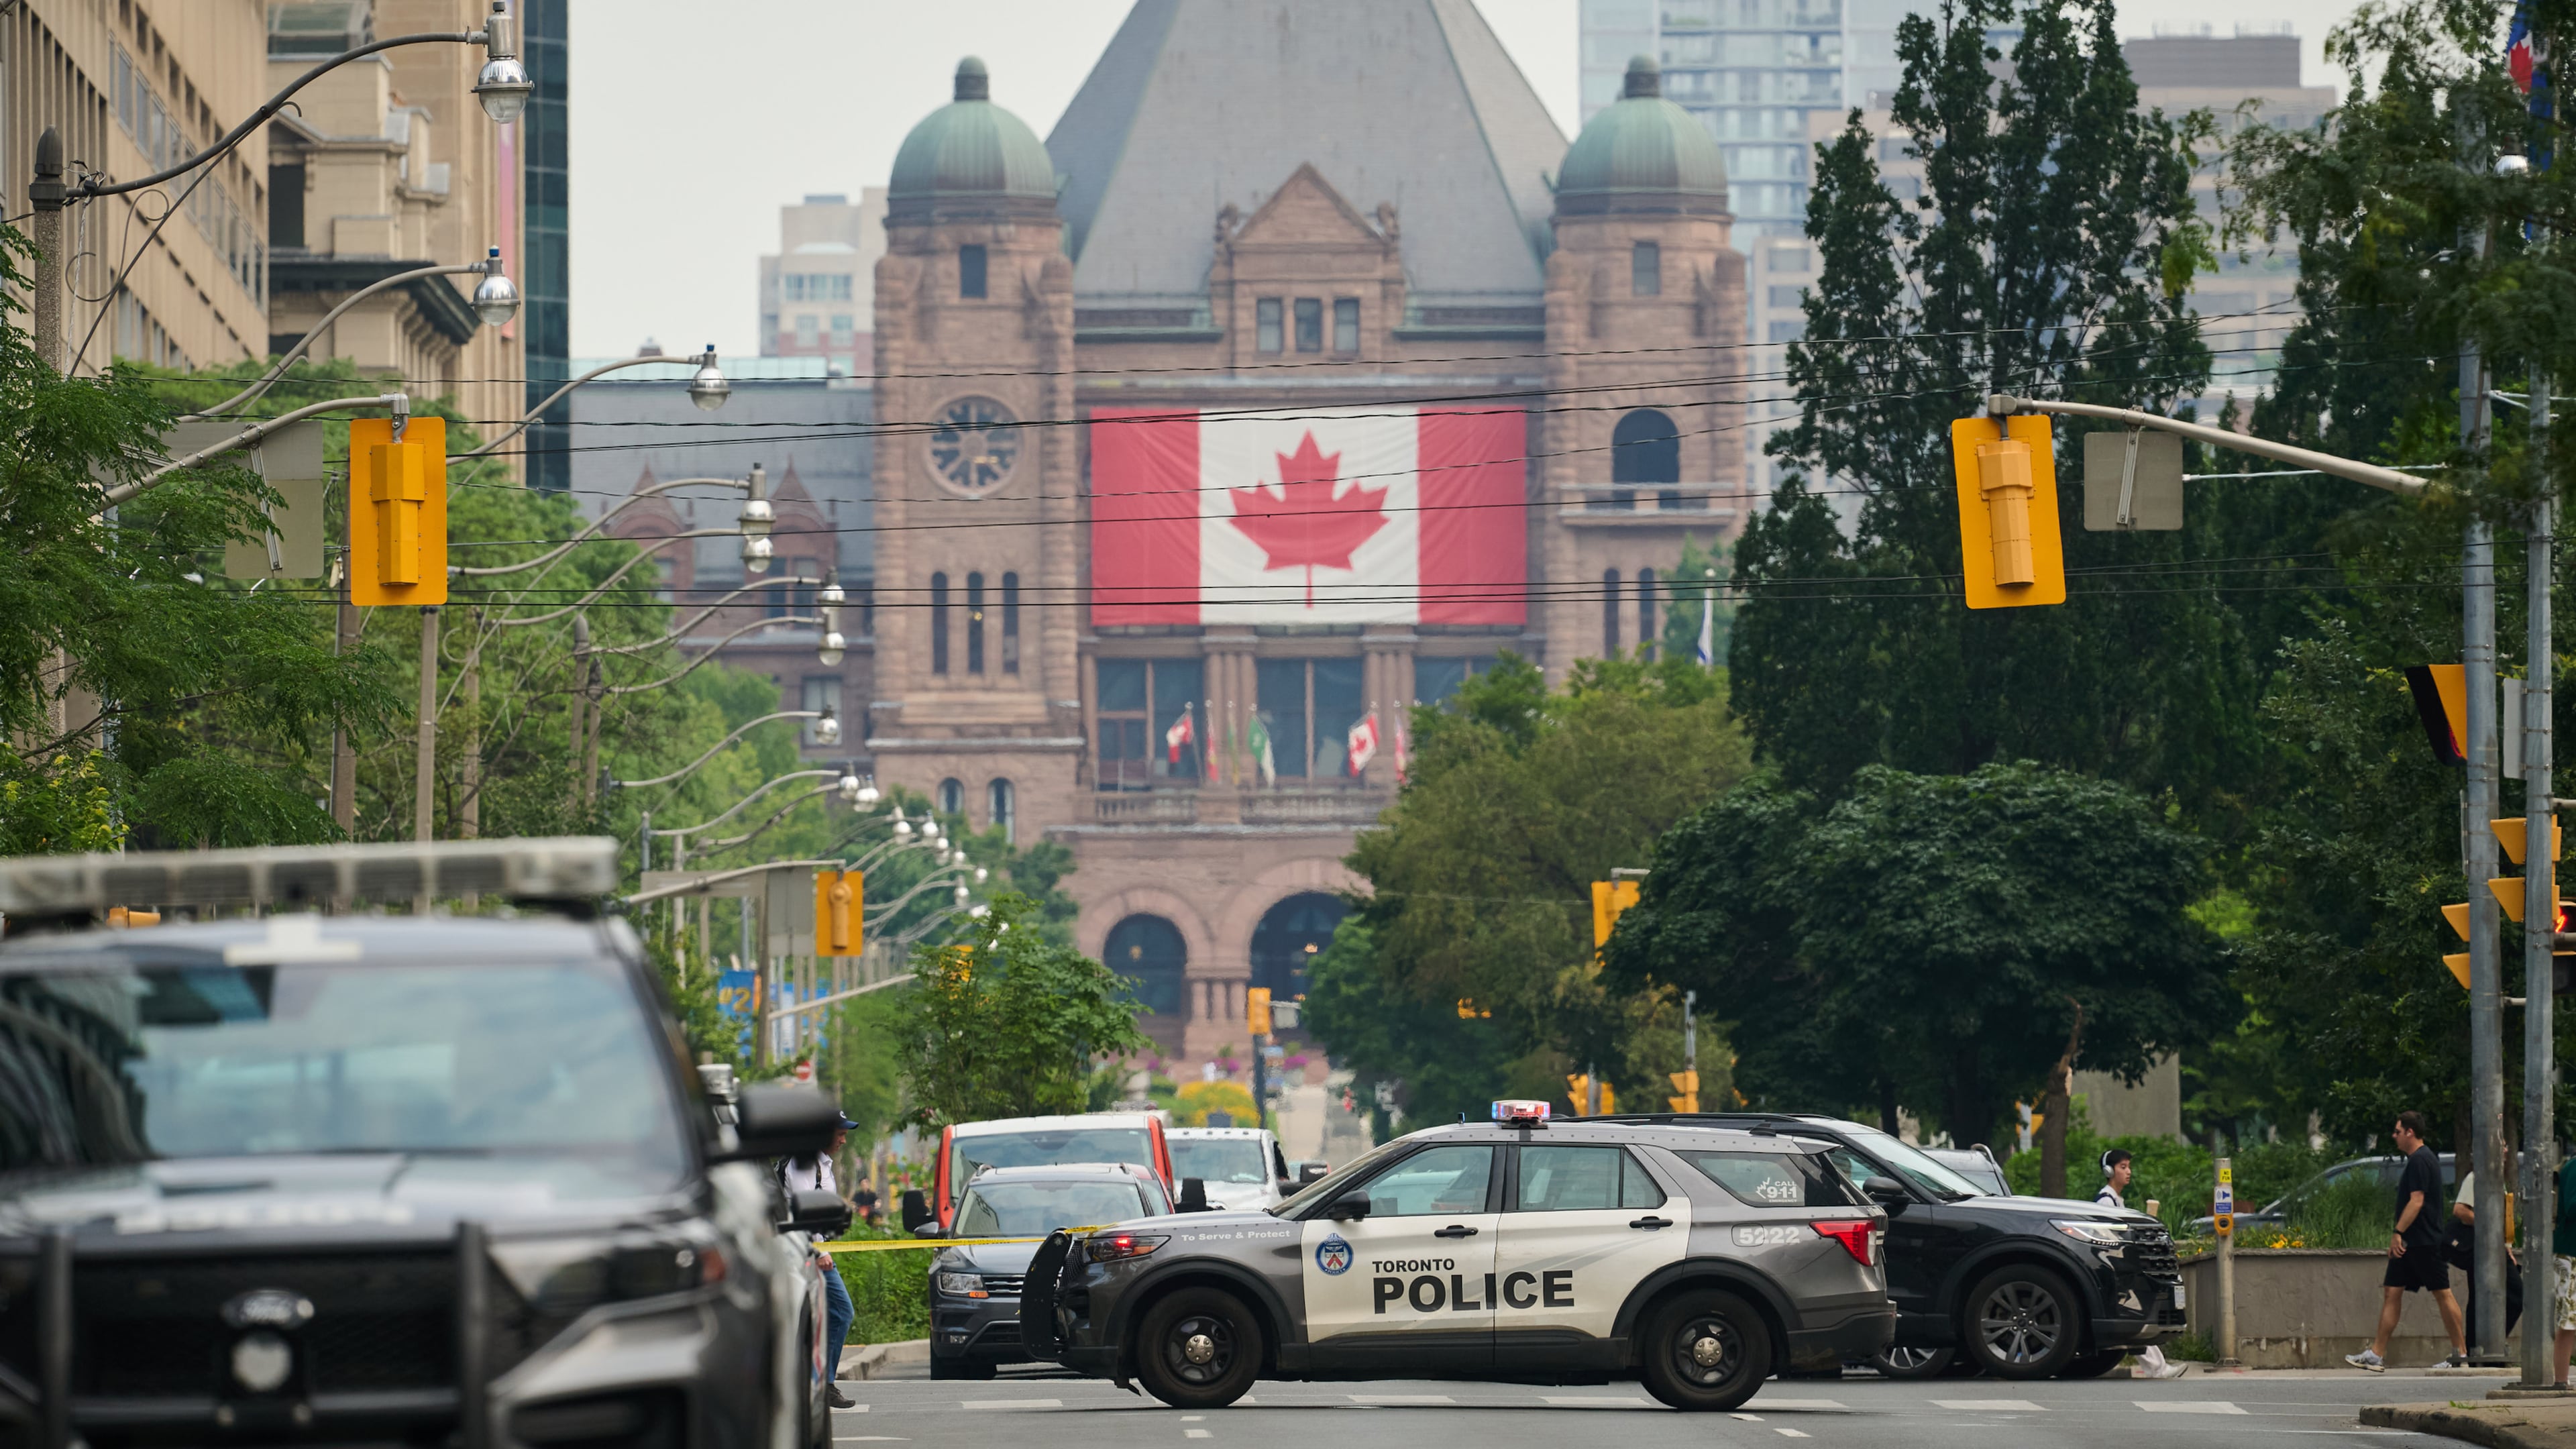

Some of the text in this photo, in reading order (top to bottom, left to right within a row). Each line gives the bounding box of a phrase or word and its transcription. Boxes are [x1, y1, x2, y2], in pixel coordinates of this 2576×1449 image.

[1766, 1187, 1797, 1198] 9-1-1
[1248, 1230, 1291, 1238] Protect
[1739, 1227, 1801, 1244] 5222
[1373, 1258, 1455, 1273] TORONTO
[1373, 1271, 1574, 1315] POLICE
